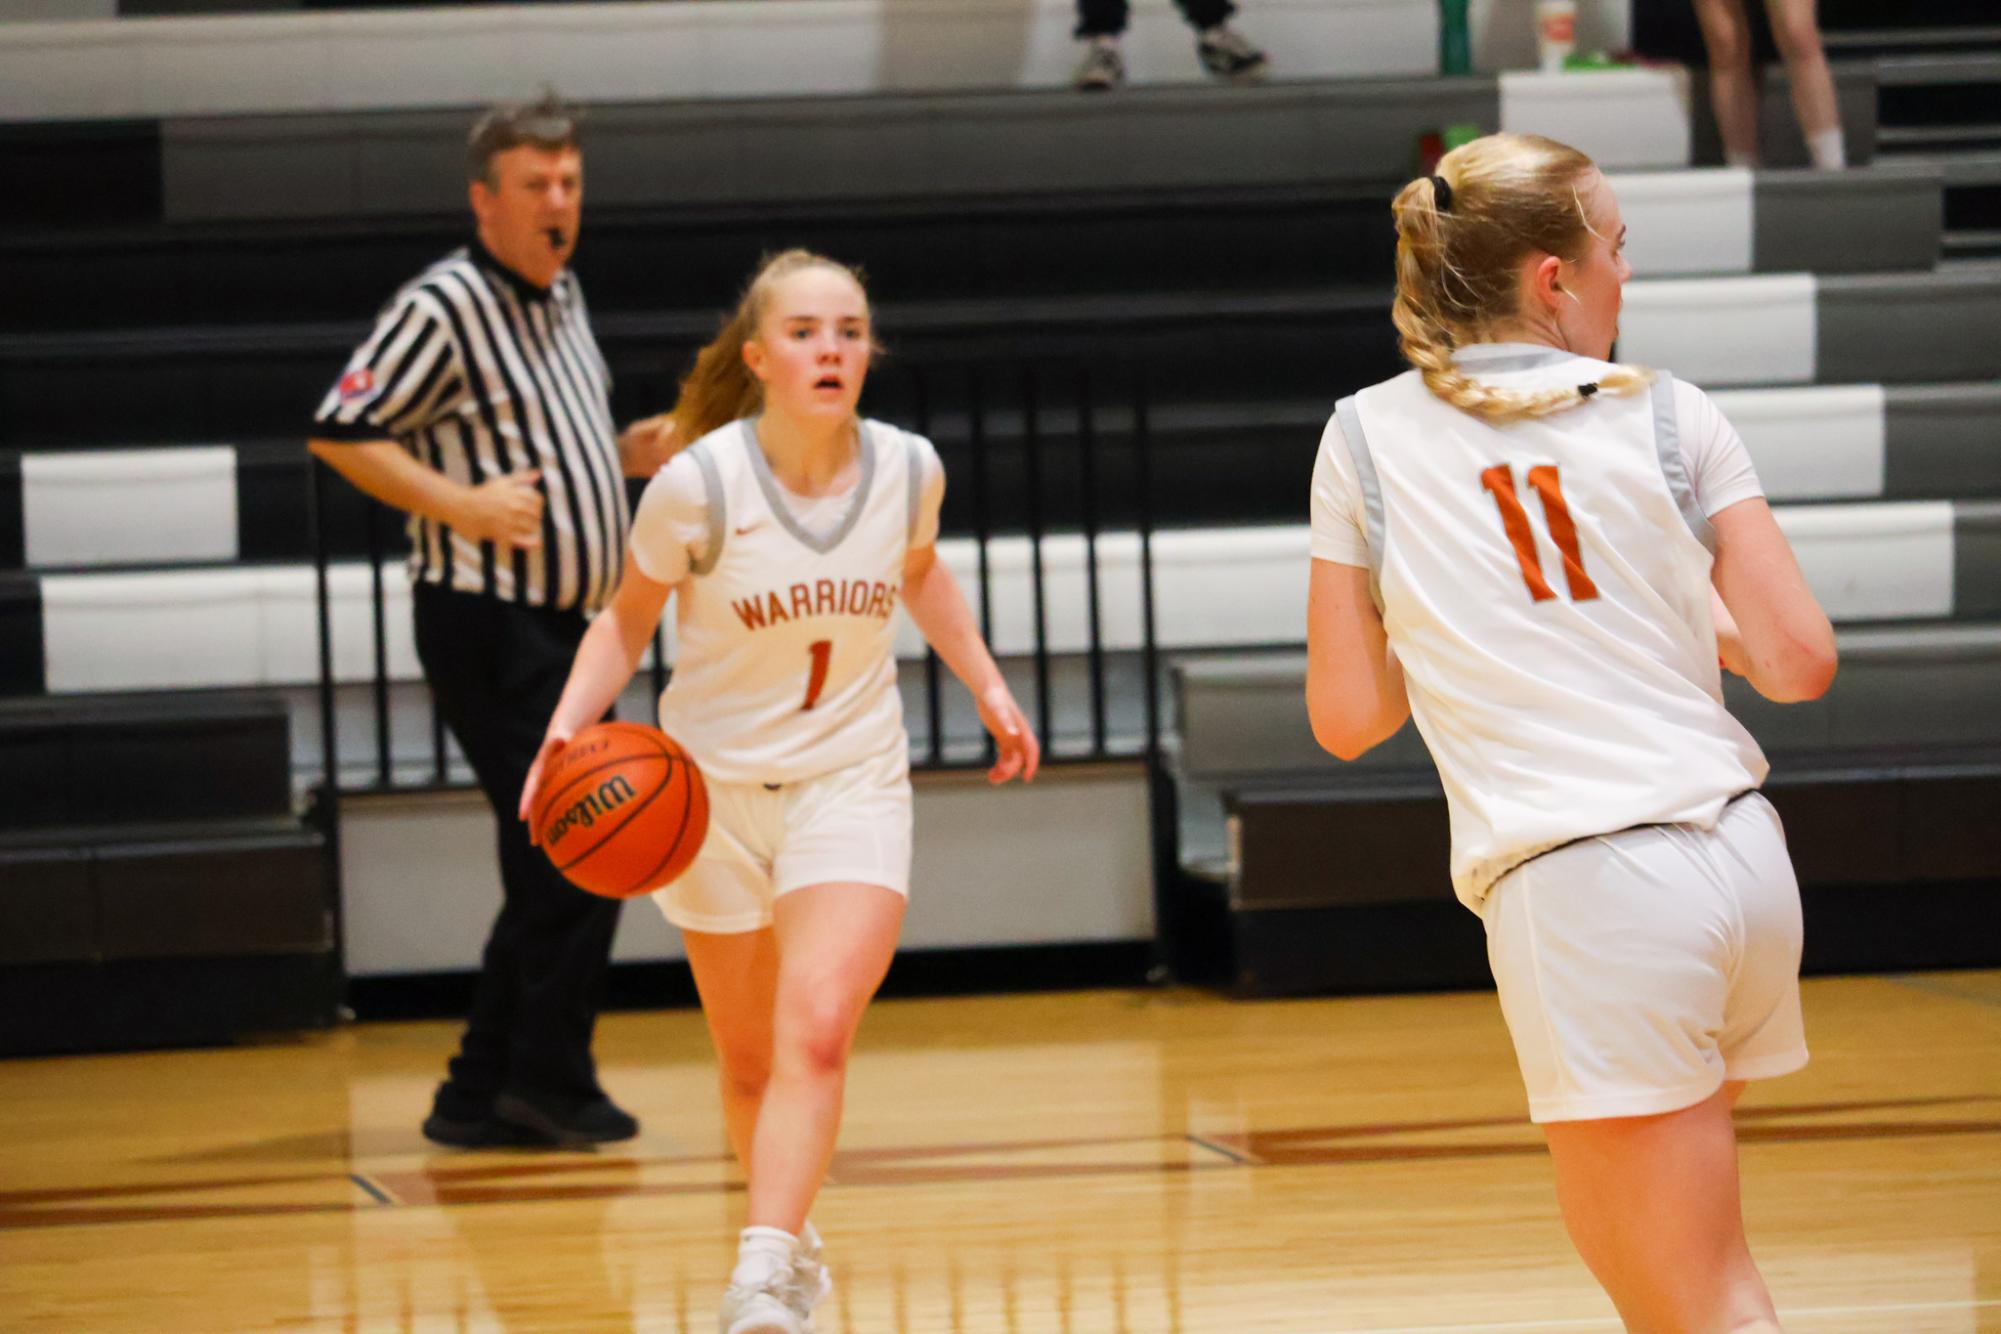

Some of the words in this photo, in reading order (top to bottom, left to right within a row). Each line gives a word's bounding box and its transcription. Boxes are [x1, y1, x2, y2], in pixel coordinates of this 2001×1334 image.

[1479, 462, 1600, 603] 11
[731, 578, 897, 631] WARRIORS
[800, 639, 832, 711] 1
[545, 774, 637, 846] Wilson
